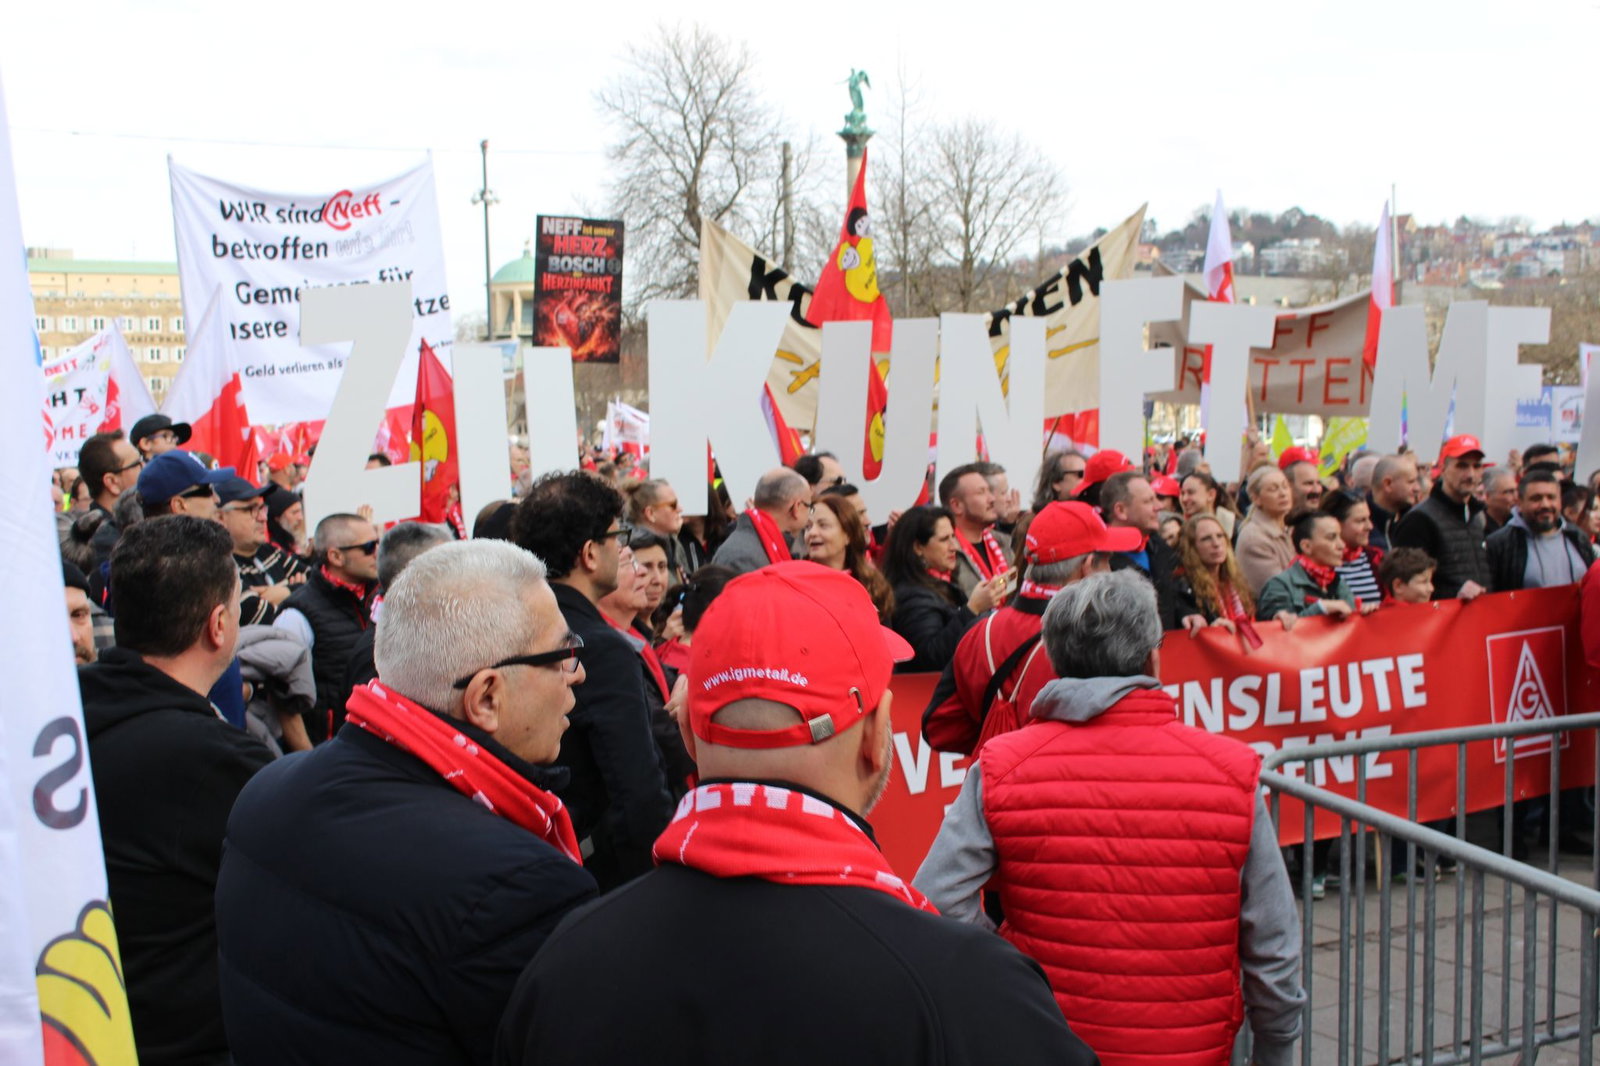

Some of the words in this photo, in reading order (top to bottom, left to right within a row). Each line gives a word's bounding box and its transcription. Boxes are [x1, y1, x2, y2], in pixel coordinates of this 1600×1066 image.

[275, 202, 326, 224] sind
[542, 217, 583, 236] NEFF
[211, 234, 328, 260] betroffen
[553, 235, 607, 257] HERZ
[547, 255, 606, 274] BOSCH
[542, 271, 614, 294] HERZINFARKT
[1270, 311, 1335, 351] FF
[244, 362, 276, 378] Geld
[327, 356, 344, 370] als
[1178, 346, 1375, 406] RTTEN
[702, 666, 809, 692] www.igmetall.de
